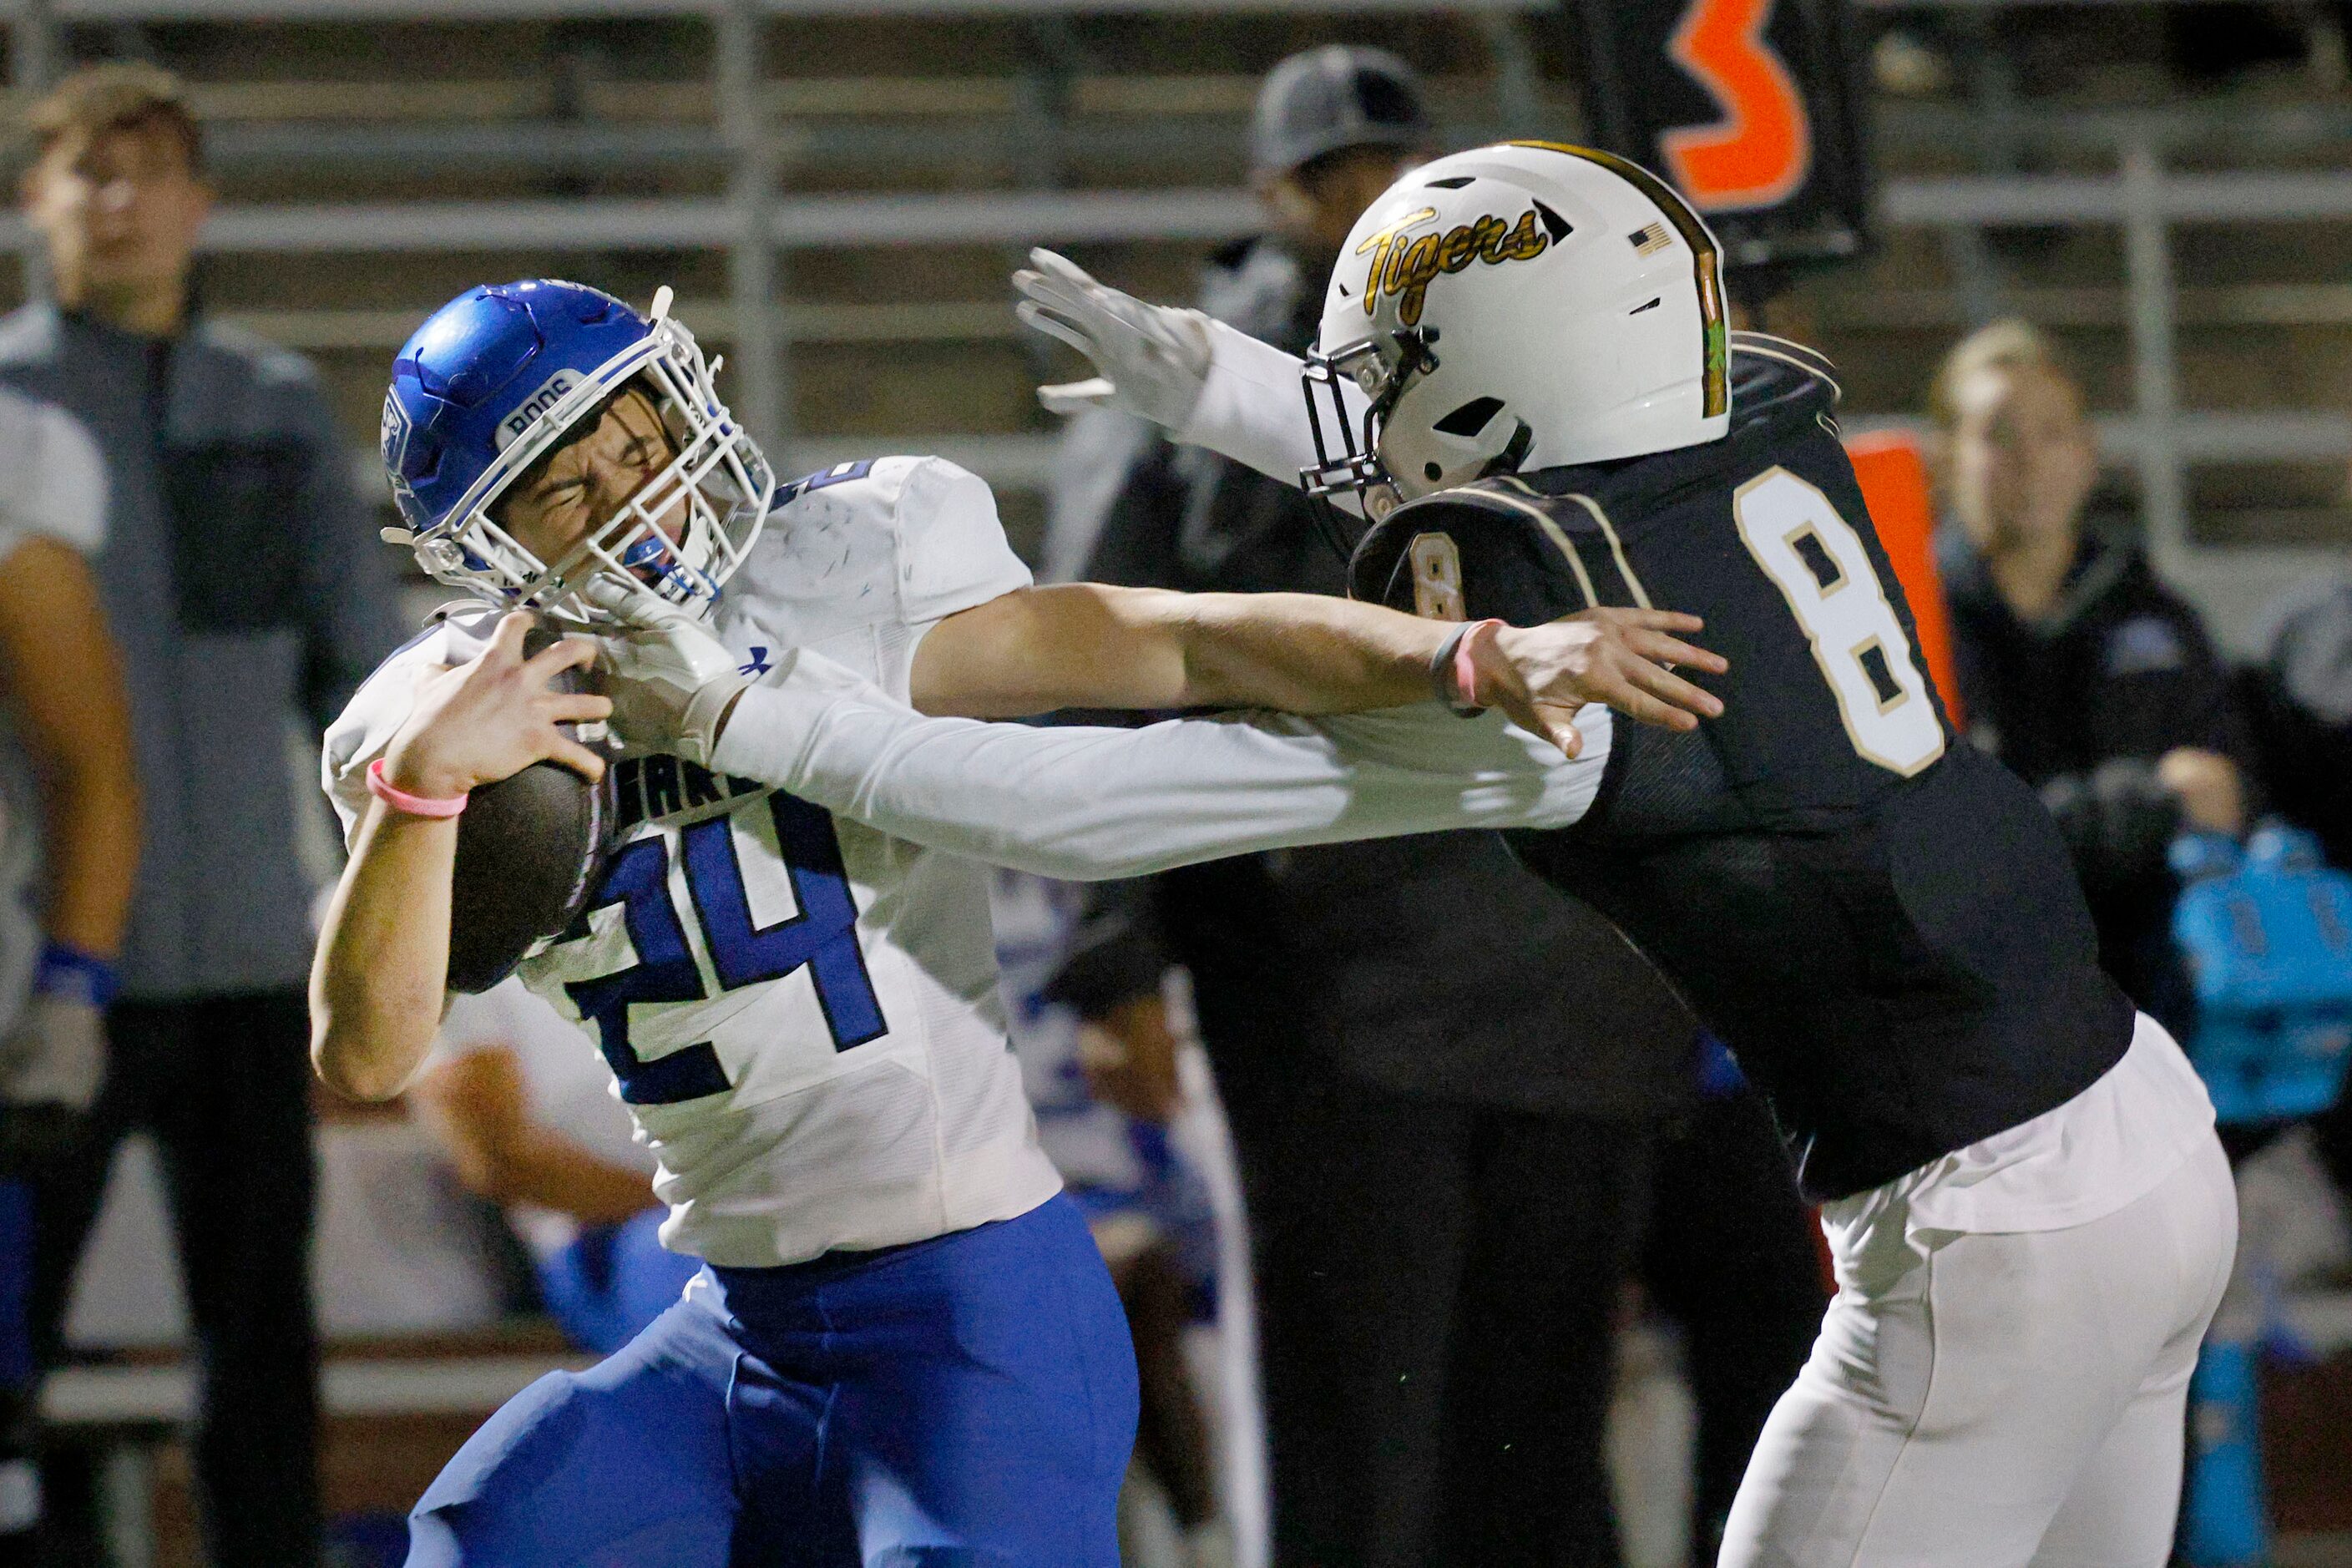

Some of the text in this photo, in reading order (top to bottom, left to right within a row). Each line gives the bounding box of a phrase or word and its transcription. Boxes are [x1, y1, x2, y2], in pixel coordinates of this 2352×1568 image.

[1660, 0, 1811, 209] 3
[1356, 207, 1549, 326] Tigers
[1409, 532, 1468, 621] 8
[1732, 464, 1945, 778] 8
[562, 787, 890, 1105] 24
